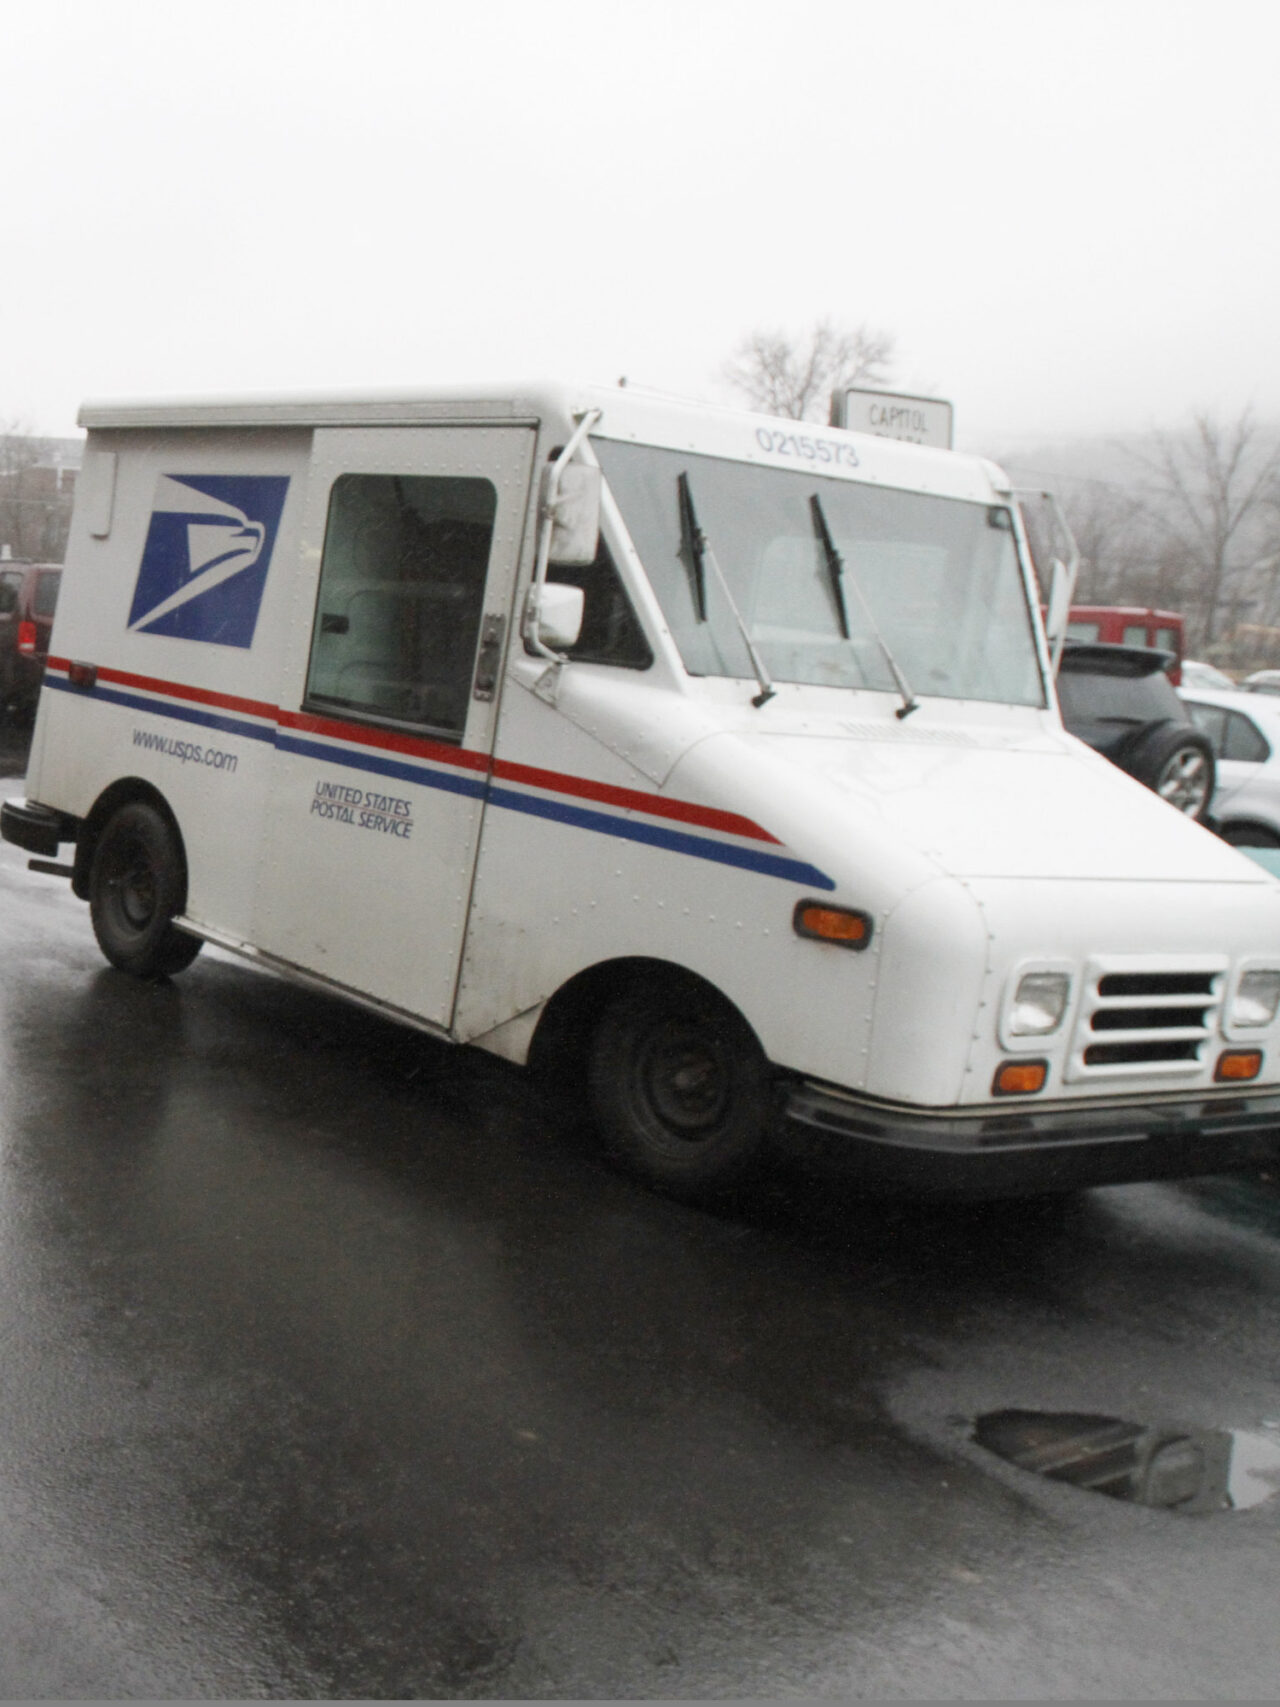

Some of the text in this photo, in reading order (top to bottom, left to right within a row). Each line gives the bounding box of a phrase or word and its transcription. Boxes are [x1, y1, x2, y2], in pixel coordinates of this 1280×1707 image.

[870, 404, 929, 432] CAPITOL
[755, 427, 859, 467] 0215573
[132, 729, 239, 773] www.usps.com
[310, 799, 413, 839] POSTAL SERVICE
[315, 781, 412, 817] UNITED STATES
